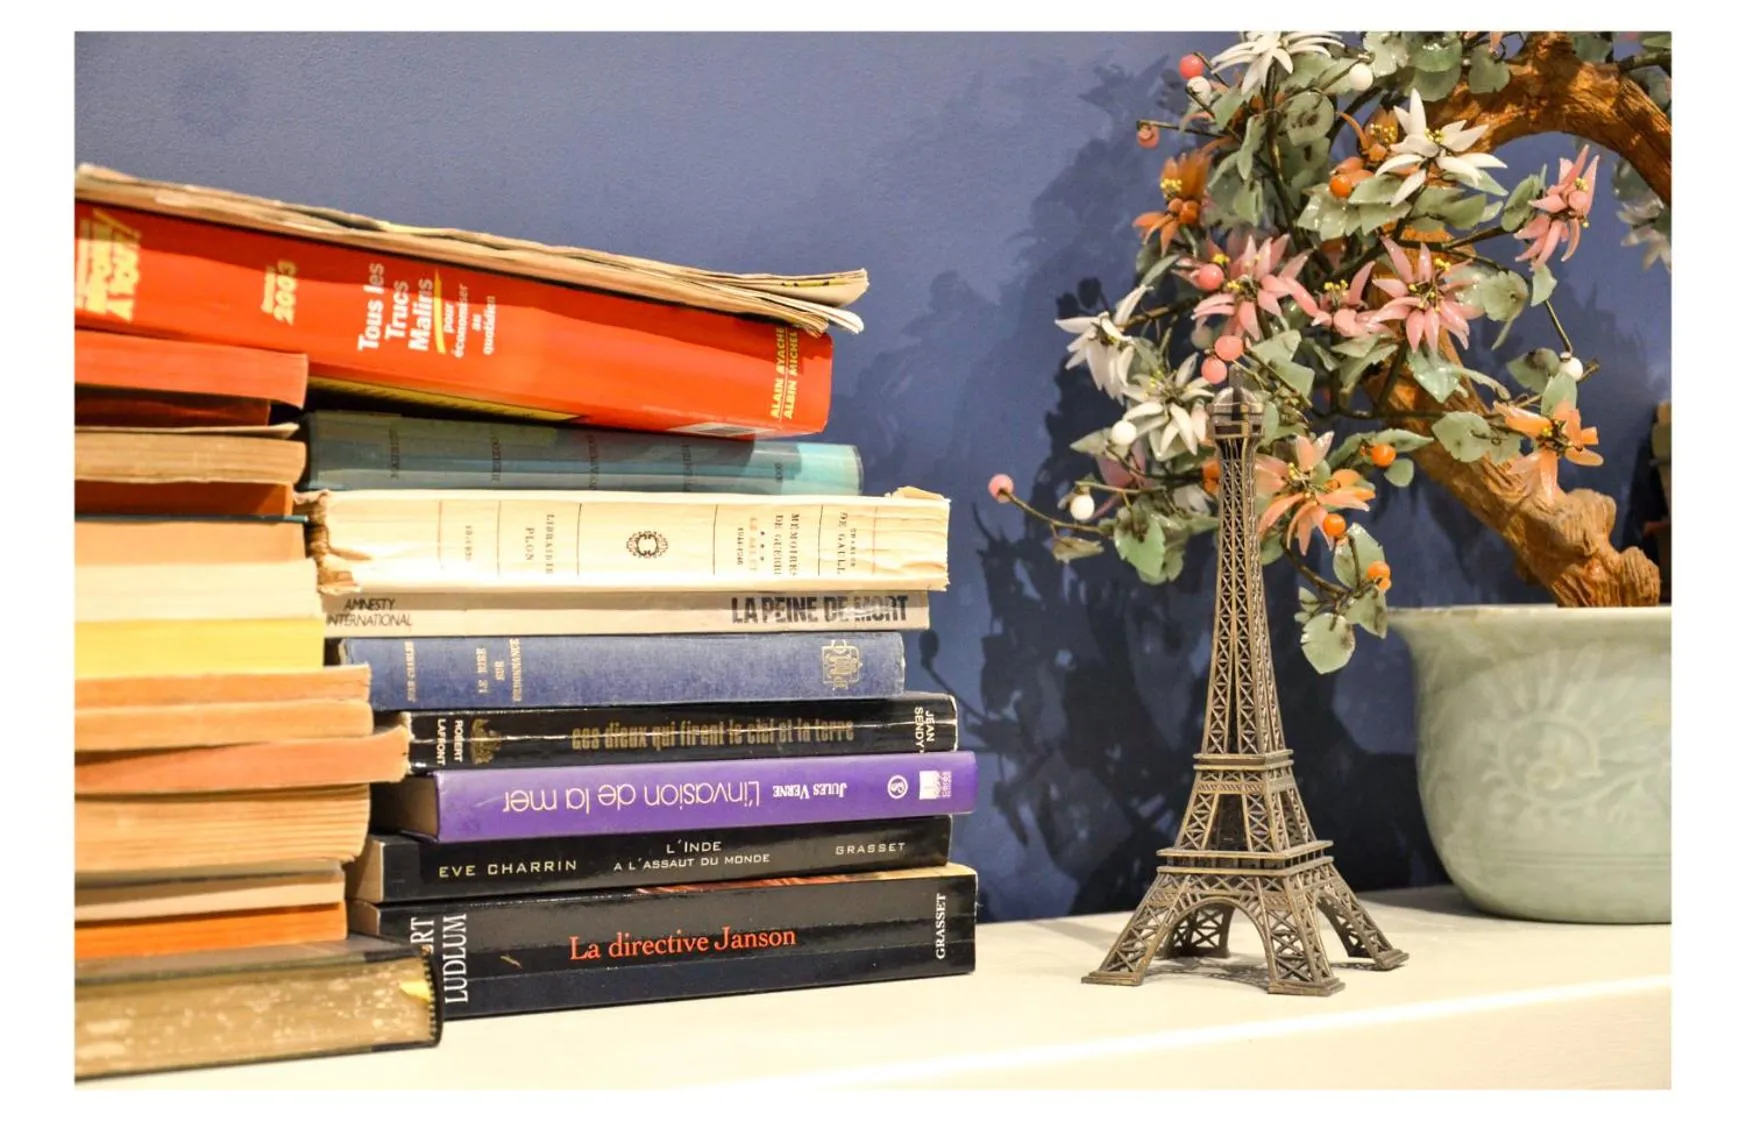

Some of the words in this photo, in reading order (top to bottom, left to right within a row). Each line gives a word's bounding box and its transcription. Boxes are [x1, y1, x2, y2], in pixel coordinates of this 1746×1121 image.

[273, 259, 299, 326] 2003
[362, 263, 385, 294] les
[357, 300, 382, 351] Tous
[384, 280, 409, 340] Trucs
[408, 279, 433, 352] Malins
[444, 302, 455, 333] pour
[452, 284, 469, 359] économiser
[472, 314, 481, 331] au
[482, 295, 496, 355] quotidien
[788, 332, 798, 376] MICHEL
[770, 378, 784, 418] ALAIN
[784, 381, 797, 419] ALBIN
[524, 527, 535, 562] PLON
[326, 612, 412, 627] INTERNATIONAL
[344, 597, 396, 610] AMNESTY
[731, 597, 758, 623] LA
[761, 597, 818, 623] PEINE
[823, 596, 849, 623] DE
[454, 720, 464, 763] ROBERT
[604, 722, 648, 749] dieux
[652, 721, 675, 751] qui
[680, 720, 724, 747] firent
[730, 719, 742, 744] le
[747, 718, 775, 744] ciel
[779, 718, 793, 743] et
[798, 718, 811, 742] la
[815, 719, 854, 742] terre
[925, 710, 935, 742] JEAN
[503, 789, 558, 813] mer
[566, 787, 590, 815] la
[598, 784, 636, 813] de
[772, 783, 809, 800] VERNE
[812, 782, 847, 799] JULES
[700, 857, 719, 866] DU
[724, 853, 770, 865] MONDE
[835, 842, 906, 856] GRASSET
[439, 865, 476, 878] EVE
[487, 859, 577, 875] CHARRIN
[934, 893, 946, 960] GRASSET
[442, 913, 468, 1003] LUDLUM
[569, 935, 600, 962] La
[607, 928, 709, 959] directive
[714, 926, 797, 955] Janson
